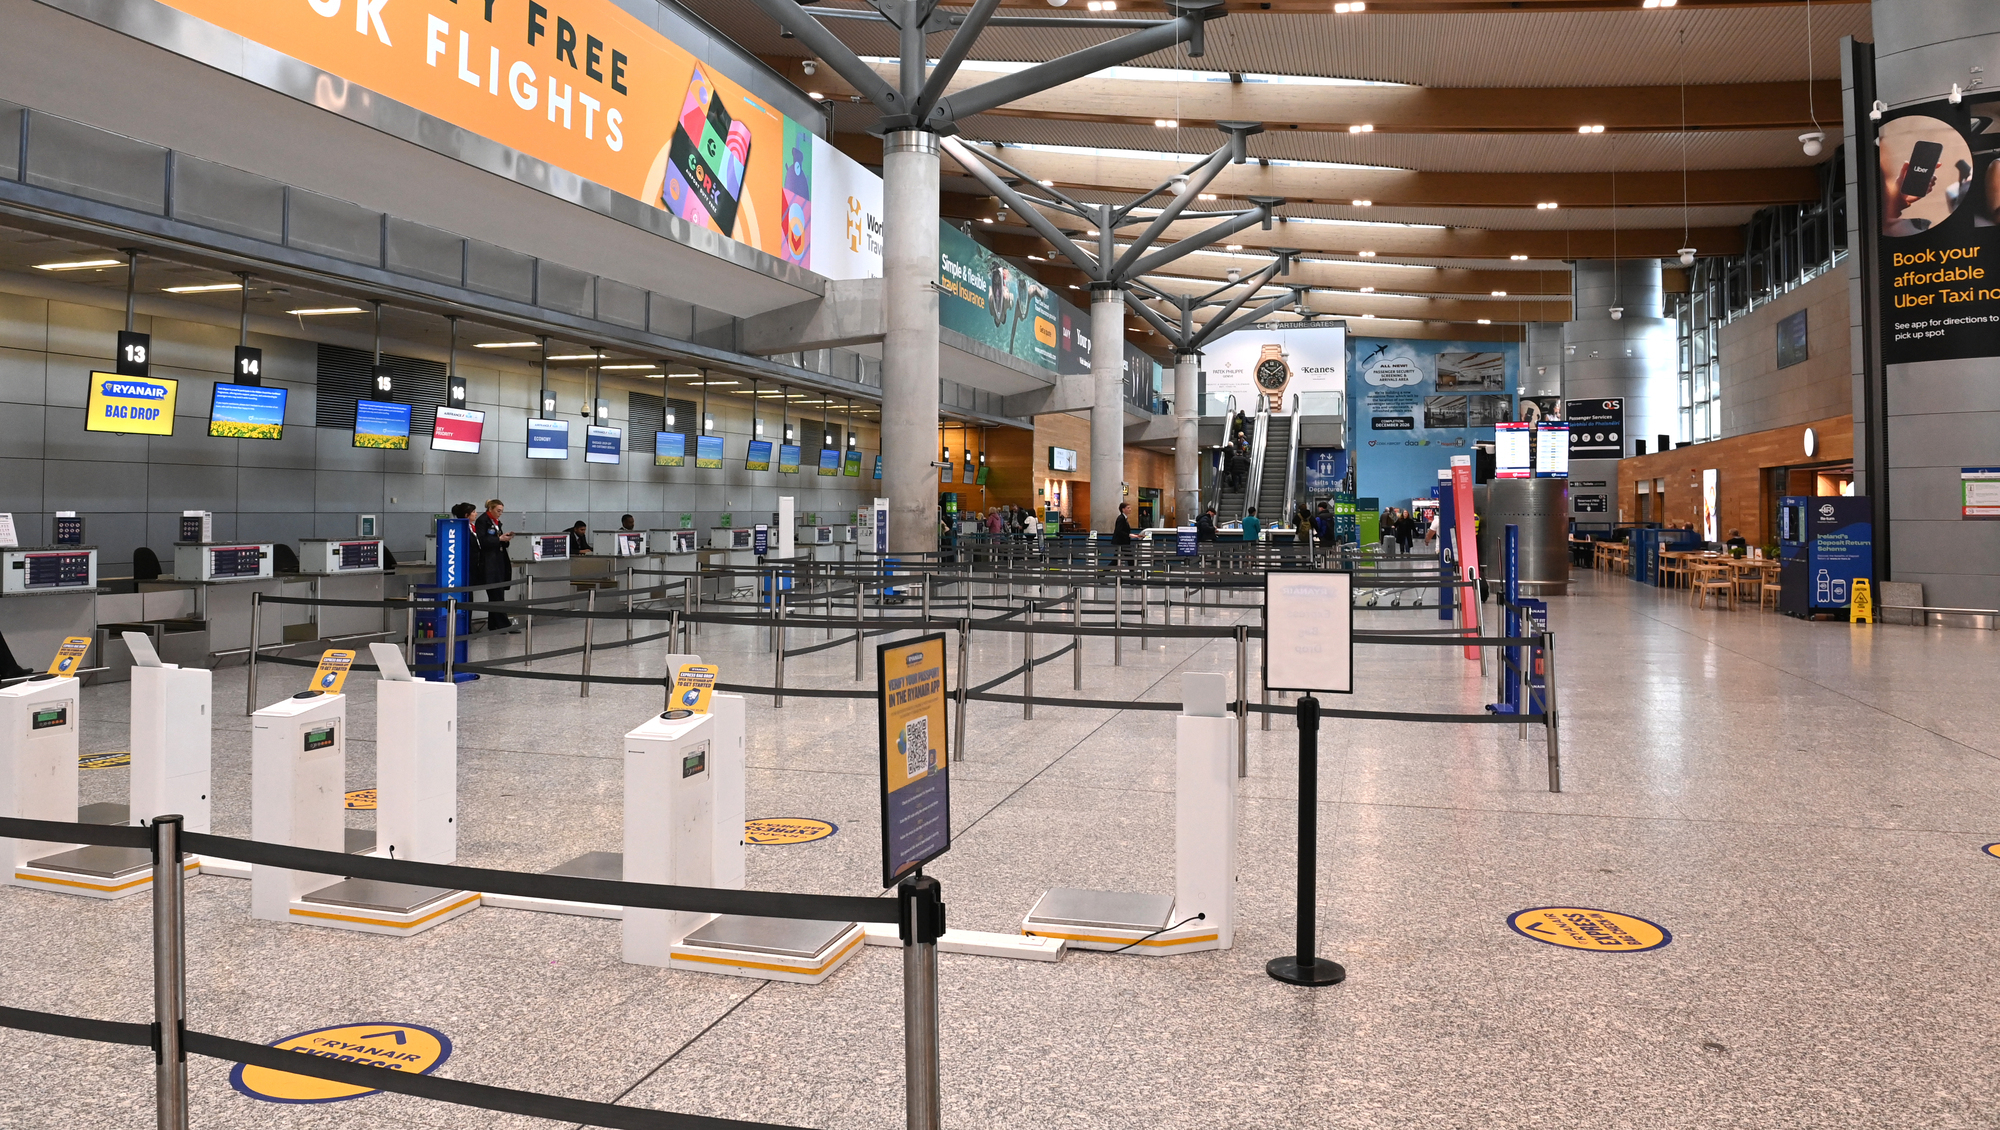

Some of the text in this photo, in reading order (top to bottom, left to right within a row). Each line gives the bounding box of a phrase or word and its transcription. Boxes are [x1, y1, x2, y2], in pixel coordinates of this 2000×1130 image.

[527, 0, 628, 96] FREE
[426, 13, 624, 153] FLIGHTS
[1913, 165, 1928, 174] Uber
[866, 233, 884, 257] Trav
[1893, 246, 1980, 267] Book your
[942, 253, 987, 293] Simple & flexible
[1893, 265, 1985, 288] affordable
[1894, 287, 2000, 309] Uber Taxi no
[1265, 321, 1310, 330] DPARTURE
[1894, 322, 1910, 330] See
[1911, 320, 1928, 329] app
[1943, 316, 1988, 326] directions
[1077, 328, 1088, 349] Your
[1895, 329, 1945, 341] pick up spot
[125, 344, 146, 363] 13
[241, 358, 259, 375] 14
[1301, 366, 1335, 374] Keanes
[112, 384, 165, 397] RYANAIR
[377, 376, 391, 391] 15
[452, 386, 465, 400] 16
[105, 405, 160, 420] BAG DROP
[544, 399, 555, 411] 17
[888, 667, 940, 692] VERIFY YOUR PASSPORT
[889, 692, 896, 709] IN
[896, 689, 907, 706] THE
[907, 682, 930, 702] RYANAIR
[930, 679, 940, 695] APP
[1543, 912, 1587, 945] RYANAIR
[1562, 912, 1623, 946] EXPRESS
[323, 1039, 421, 1063] RYANAIR
